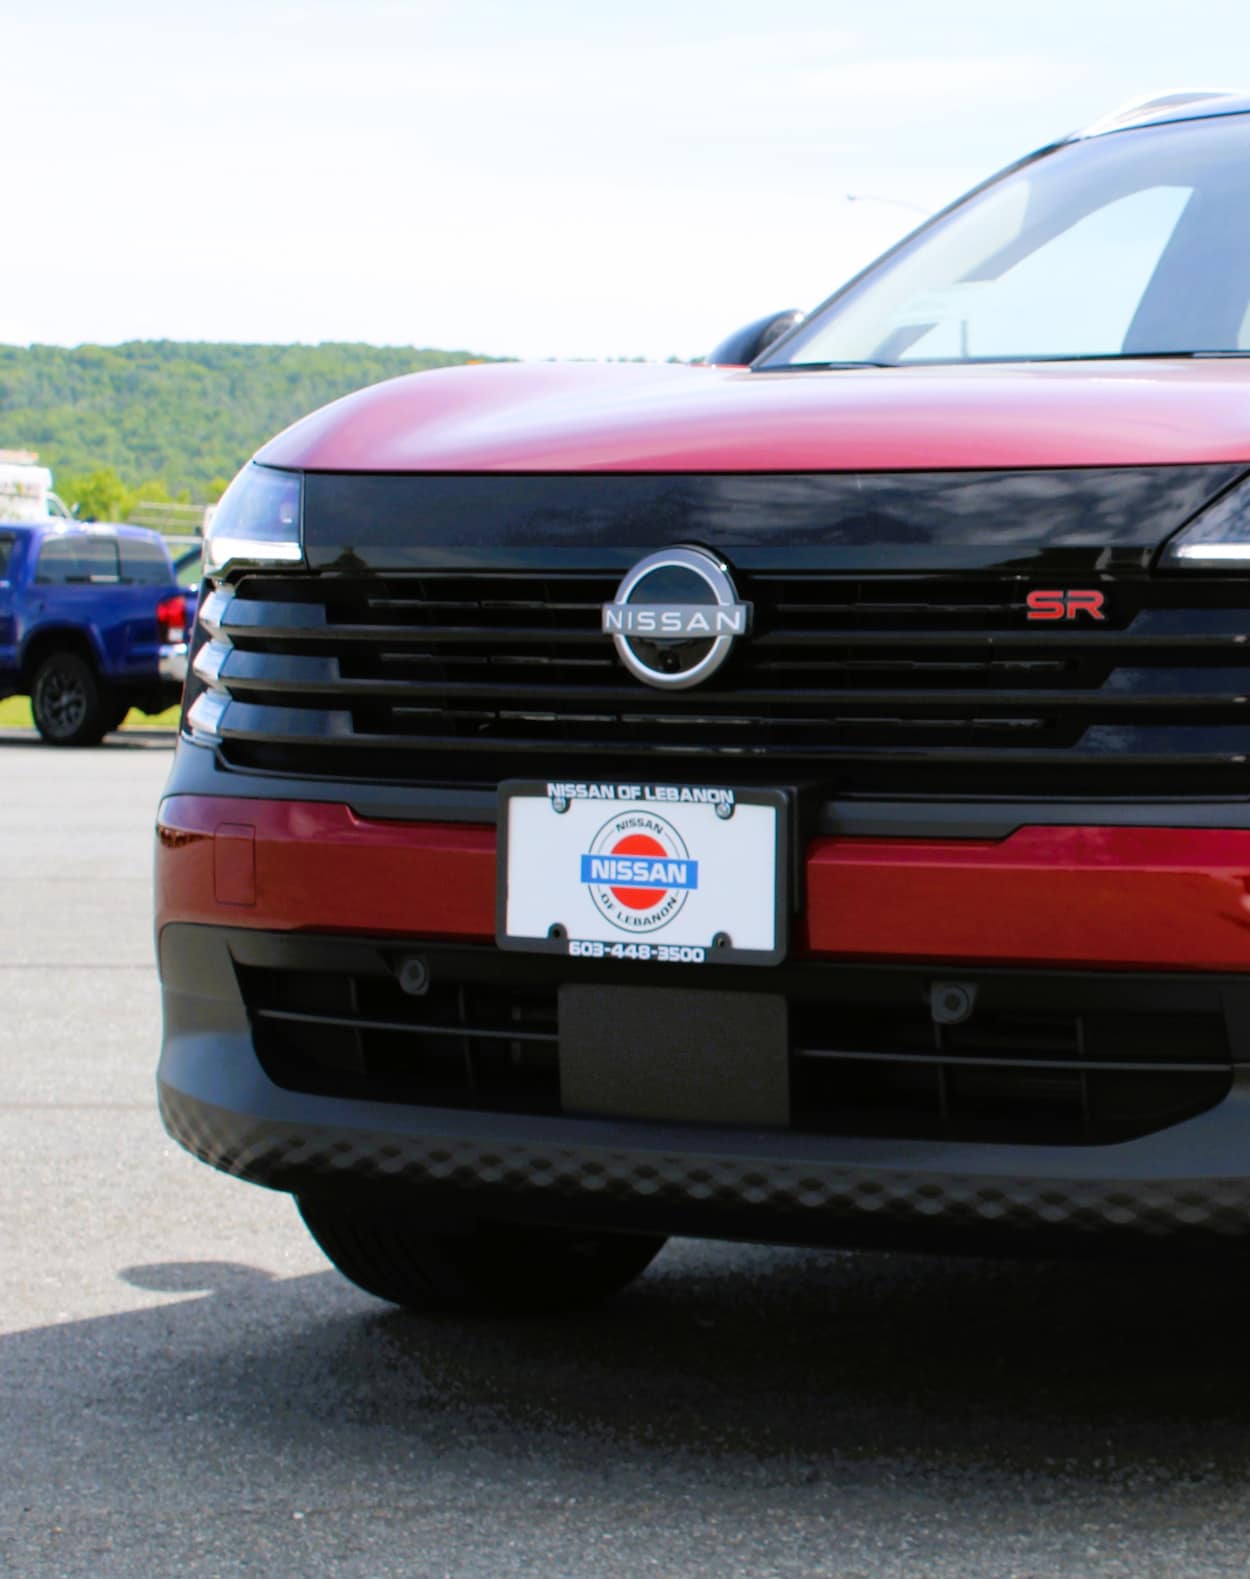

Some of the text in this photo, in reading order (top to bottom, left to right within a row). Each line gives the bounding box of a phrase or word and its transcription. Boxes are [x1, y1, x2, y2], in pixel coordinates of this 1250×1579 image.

[1026, 590, 1106, 620] SR
[605, 609, 743, 634] NISSAN
[547, 783, 734, 803] NISSAN OF LEBANON
[616, 818, 664, 834] NISSAN
[591, 860, 687, 884] NISSAN
[601, 893, 677, 926] OF LEBANON
[568, 941, 705, 962] 603-448-3500
